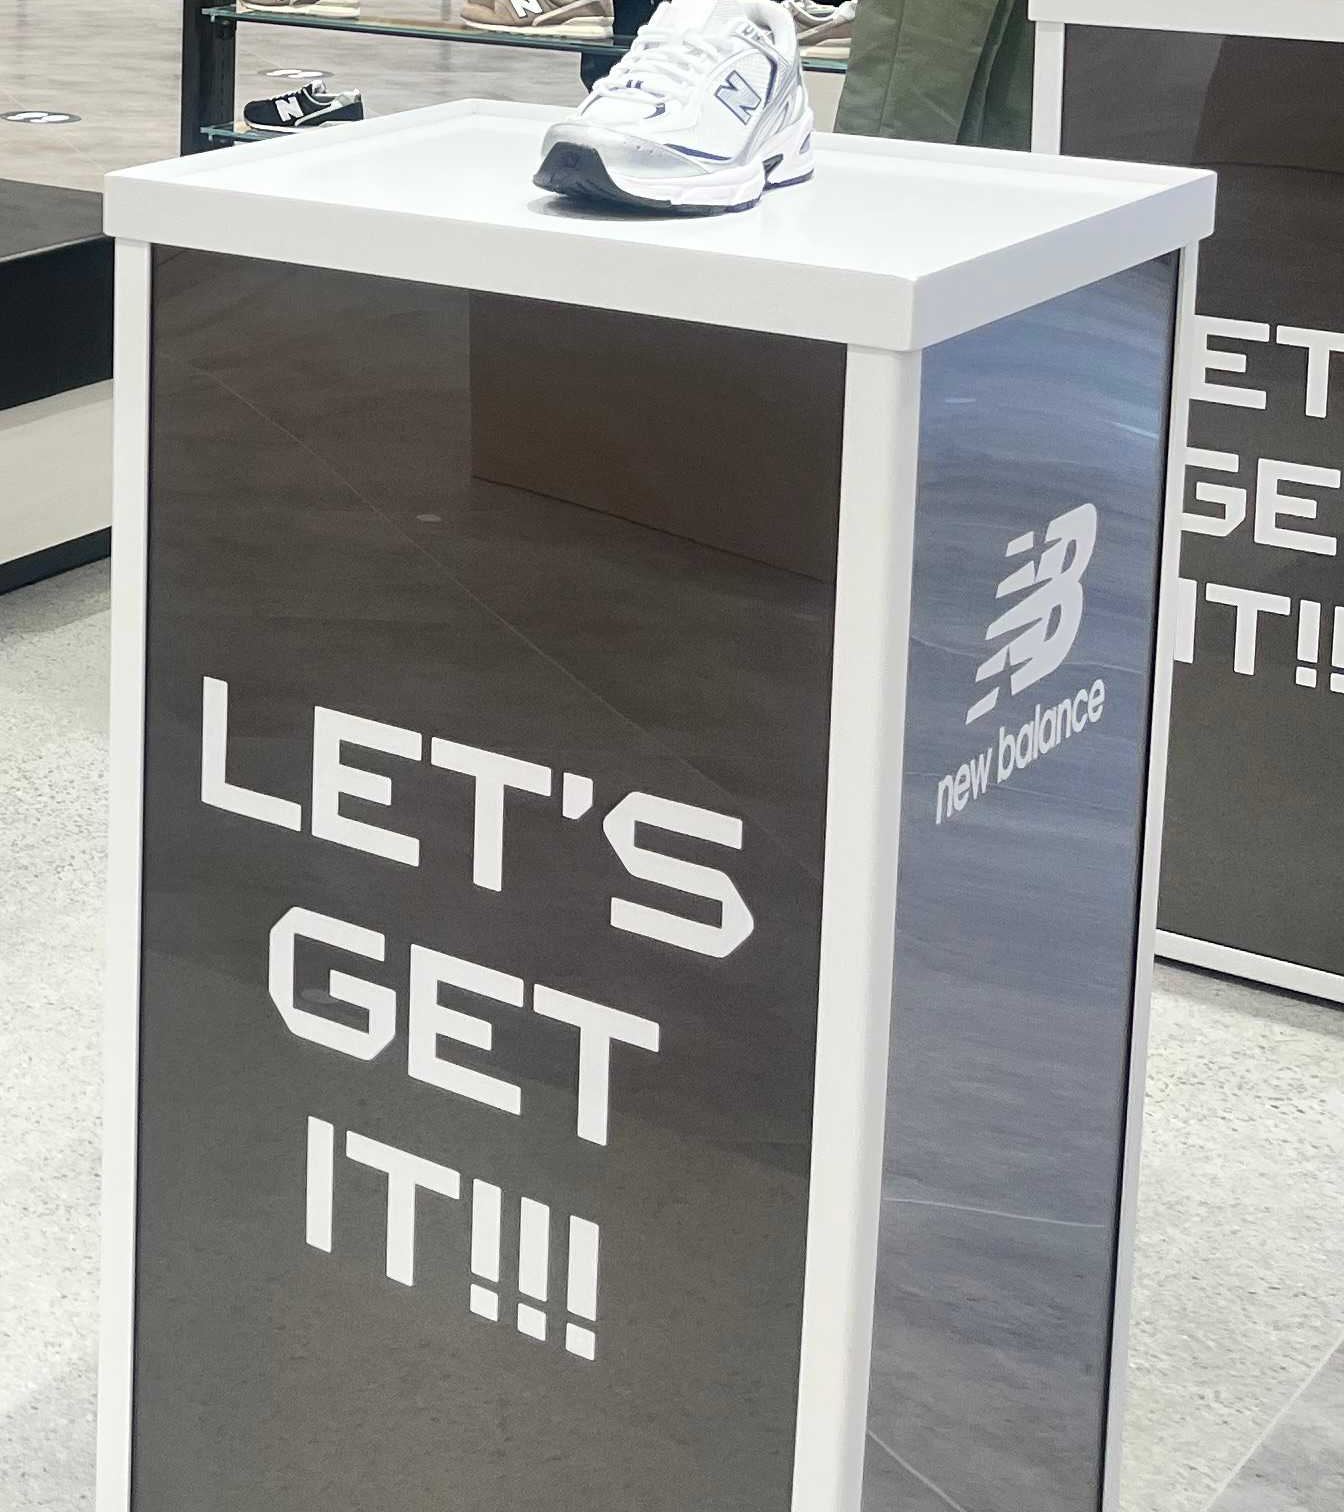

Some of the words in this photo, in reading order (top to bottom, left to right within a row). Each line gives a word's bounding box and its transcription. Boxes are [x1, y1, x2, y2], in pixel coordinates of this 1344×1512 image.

[201, 675, 754, 958] LET'S
[934, 742, 991, 826] new
[996, 677, 1106, 785] balance
[267, 906, 660, 1147] GET
[304, 1115, 600, 1361] IT!!!
